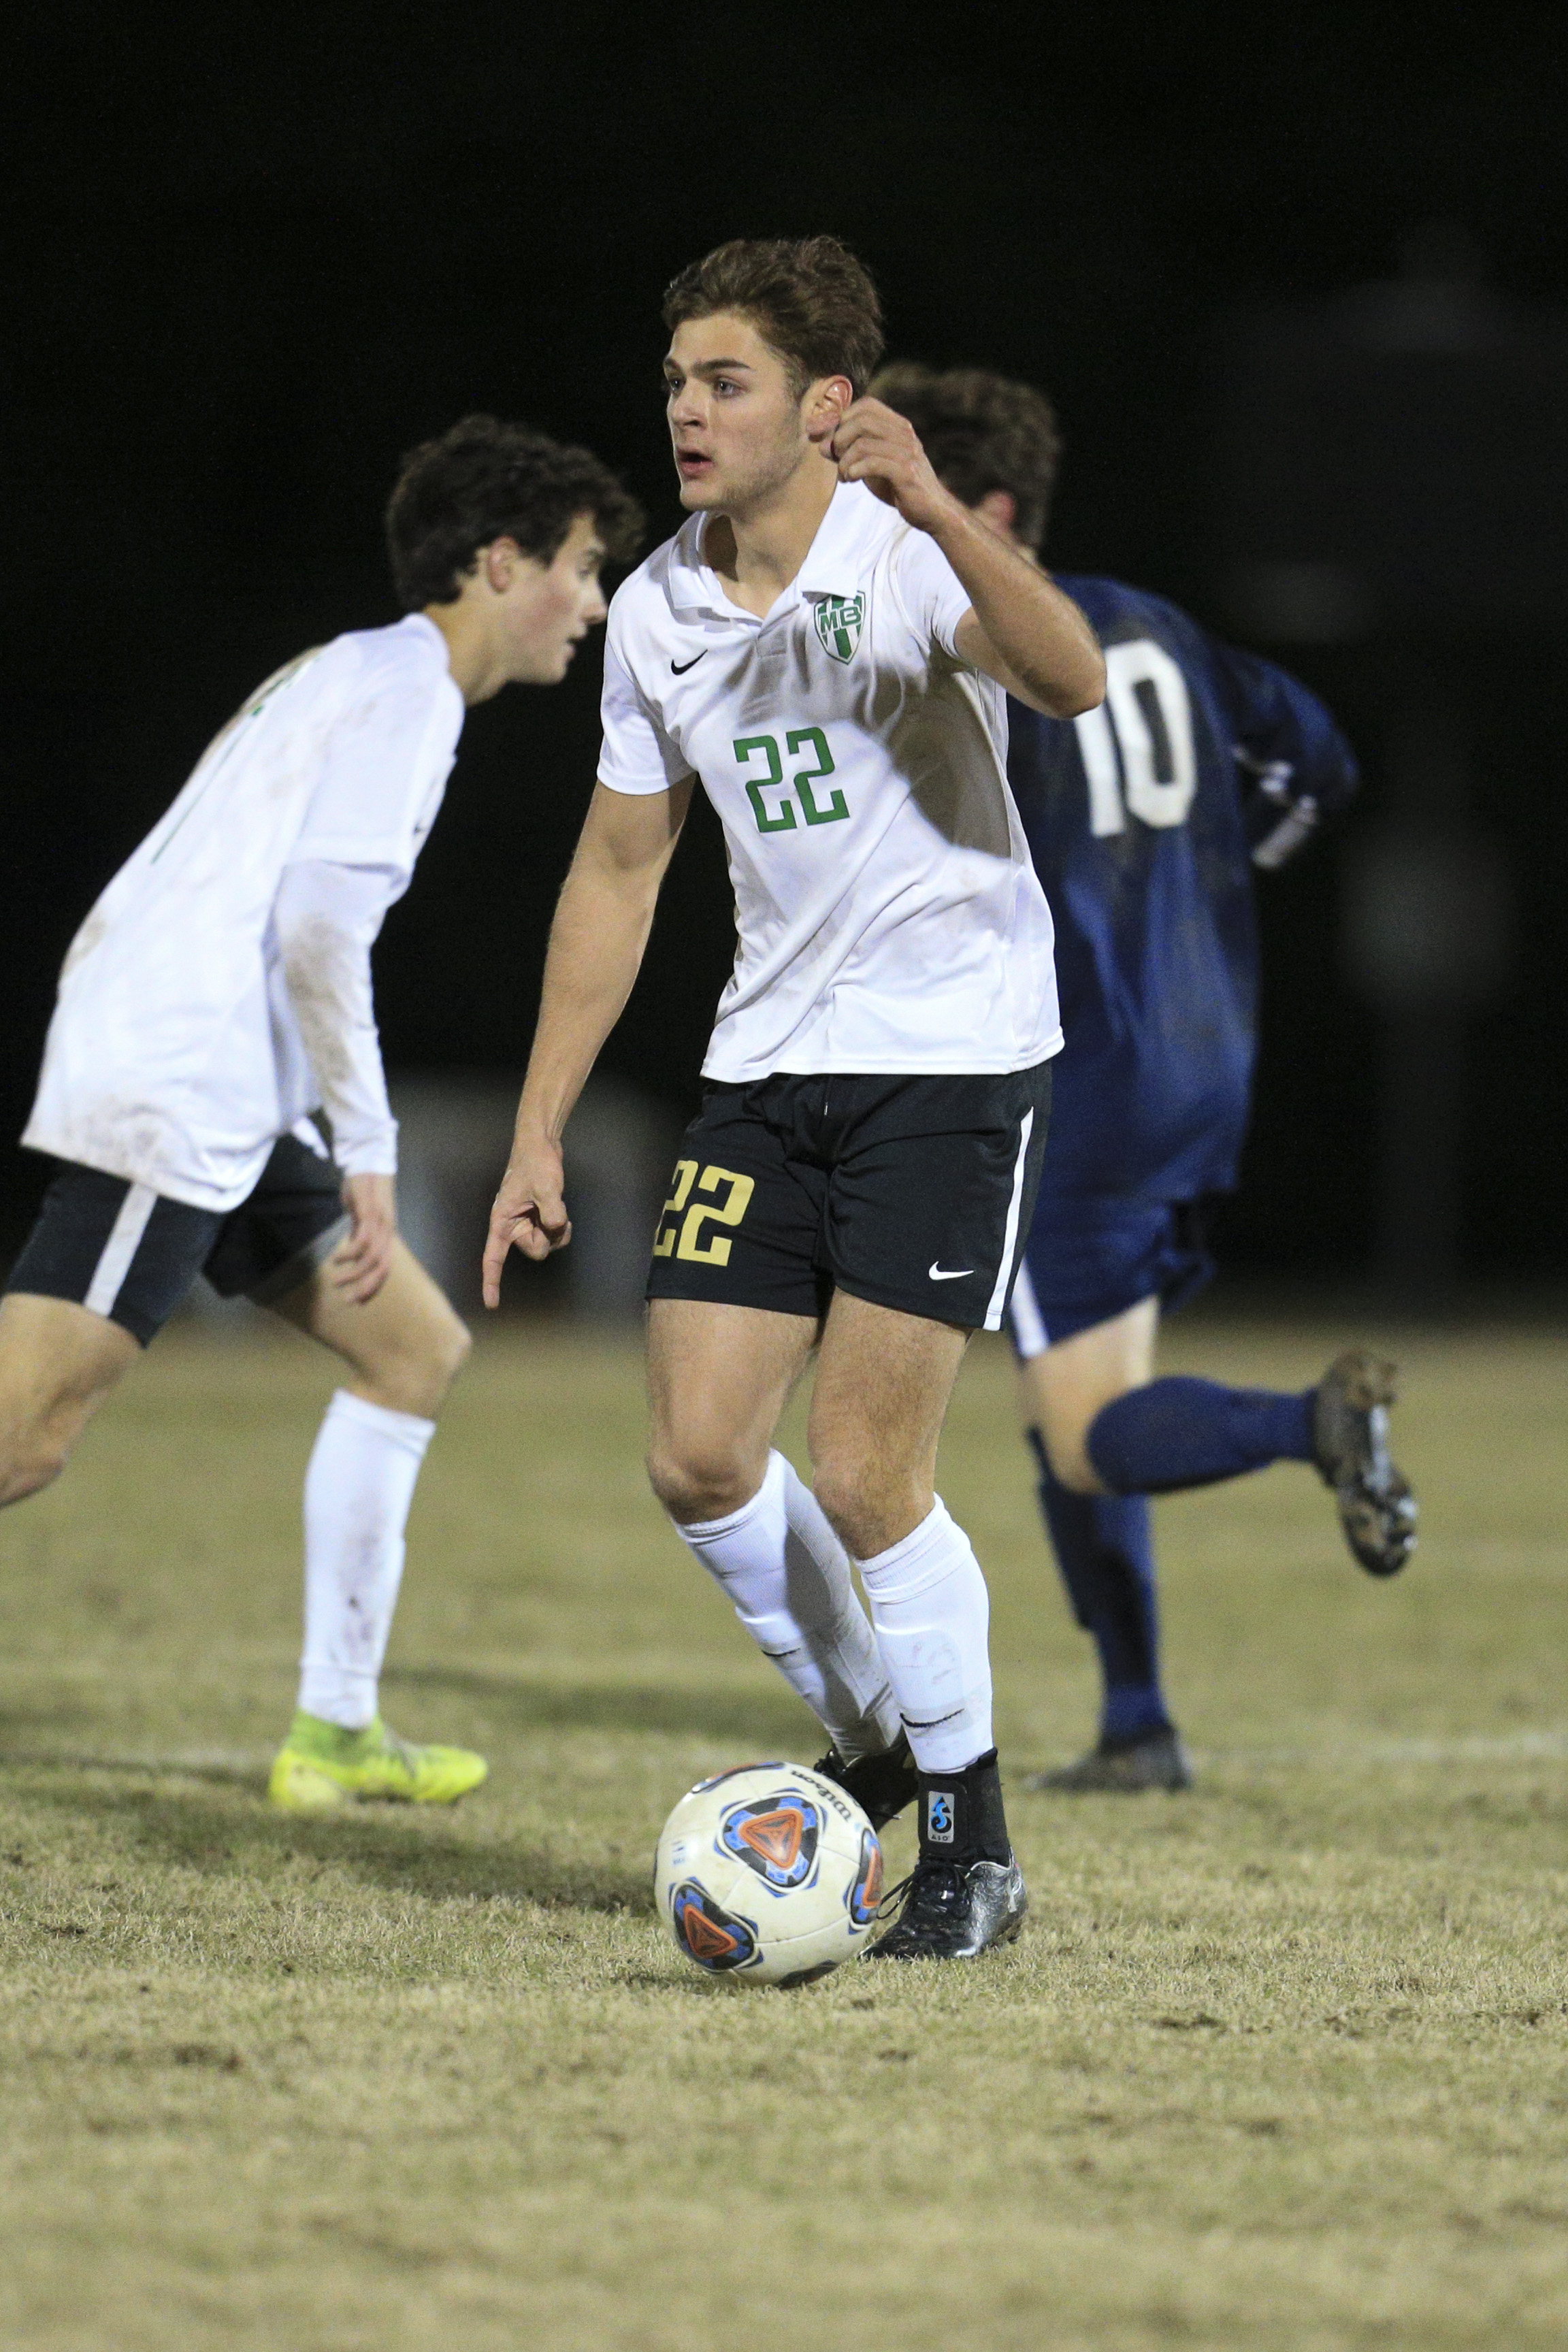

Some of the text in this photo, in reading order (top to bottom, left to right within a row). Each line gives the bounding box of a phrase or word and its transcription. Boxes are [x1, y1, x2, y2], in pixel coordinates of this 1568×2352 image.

[820, 606, 862, 635] MB
[733, 727, 850, 833] 22
[1074, 639, 1197, 837] 10
[653, 1160, 755, 1267] 22
[791, 1770, 851, 1822] Wilson
